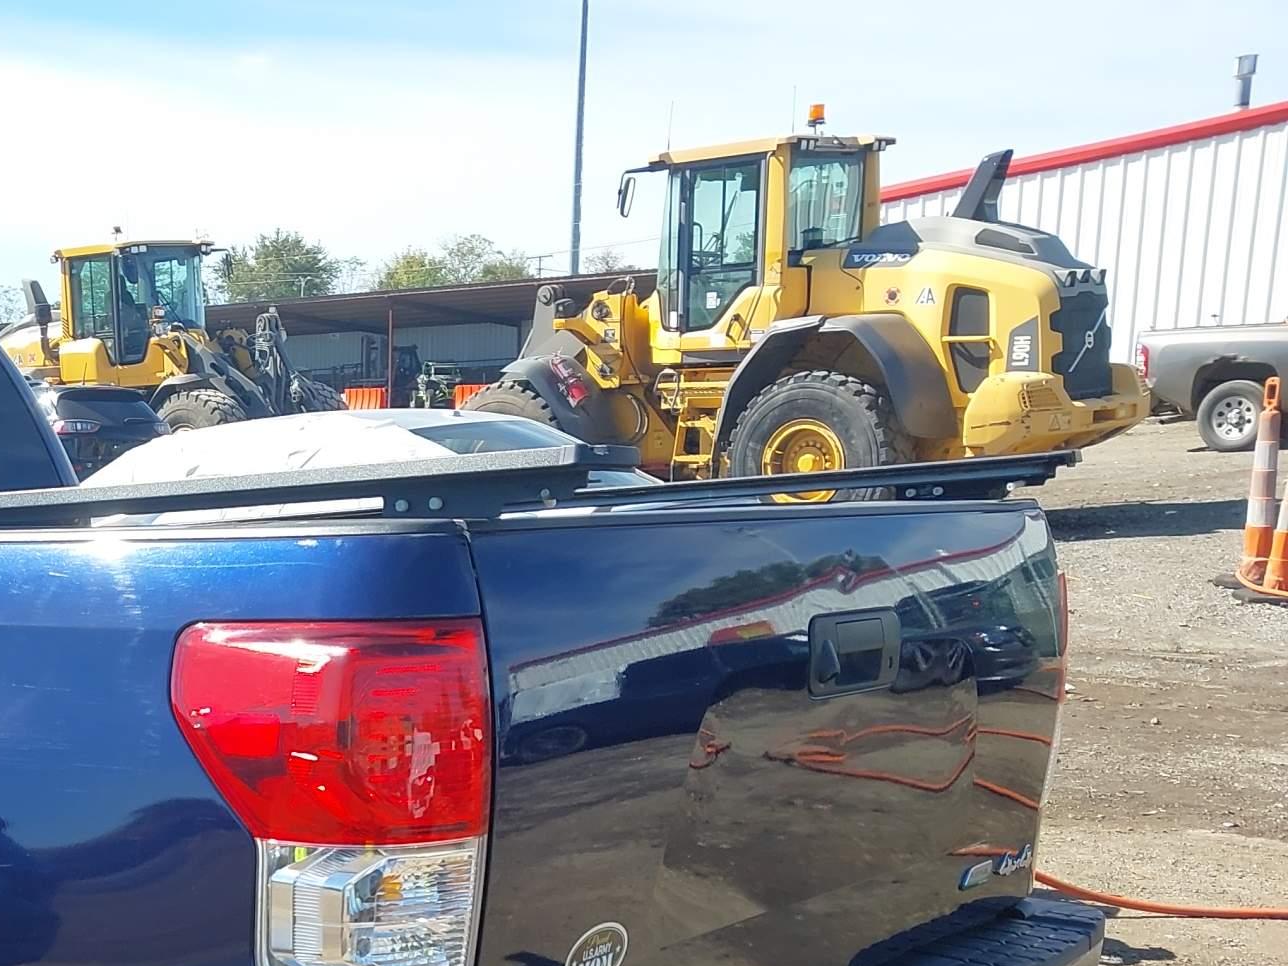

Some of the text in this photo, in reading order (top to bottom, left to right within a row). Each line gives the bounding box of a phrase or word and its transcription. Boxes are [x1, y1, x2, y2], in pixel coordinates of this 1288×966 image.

[852, 252, 911, 263] VOLVO
[1011, 336, 1031, 366] L90H
[594, 942, 613, 957] ARMY
